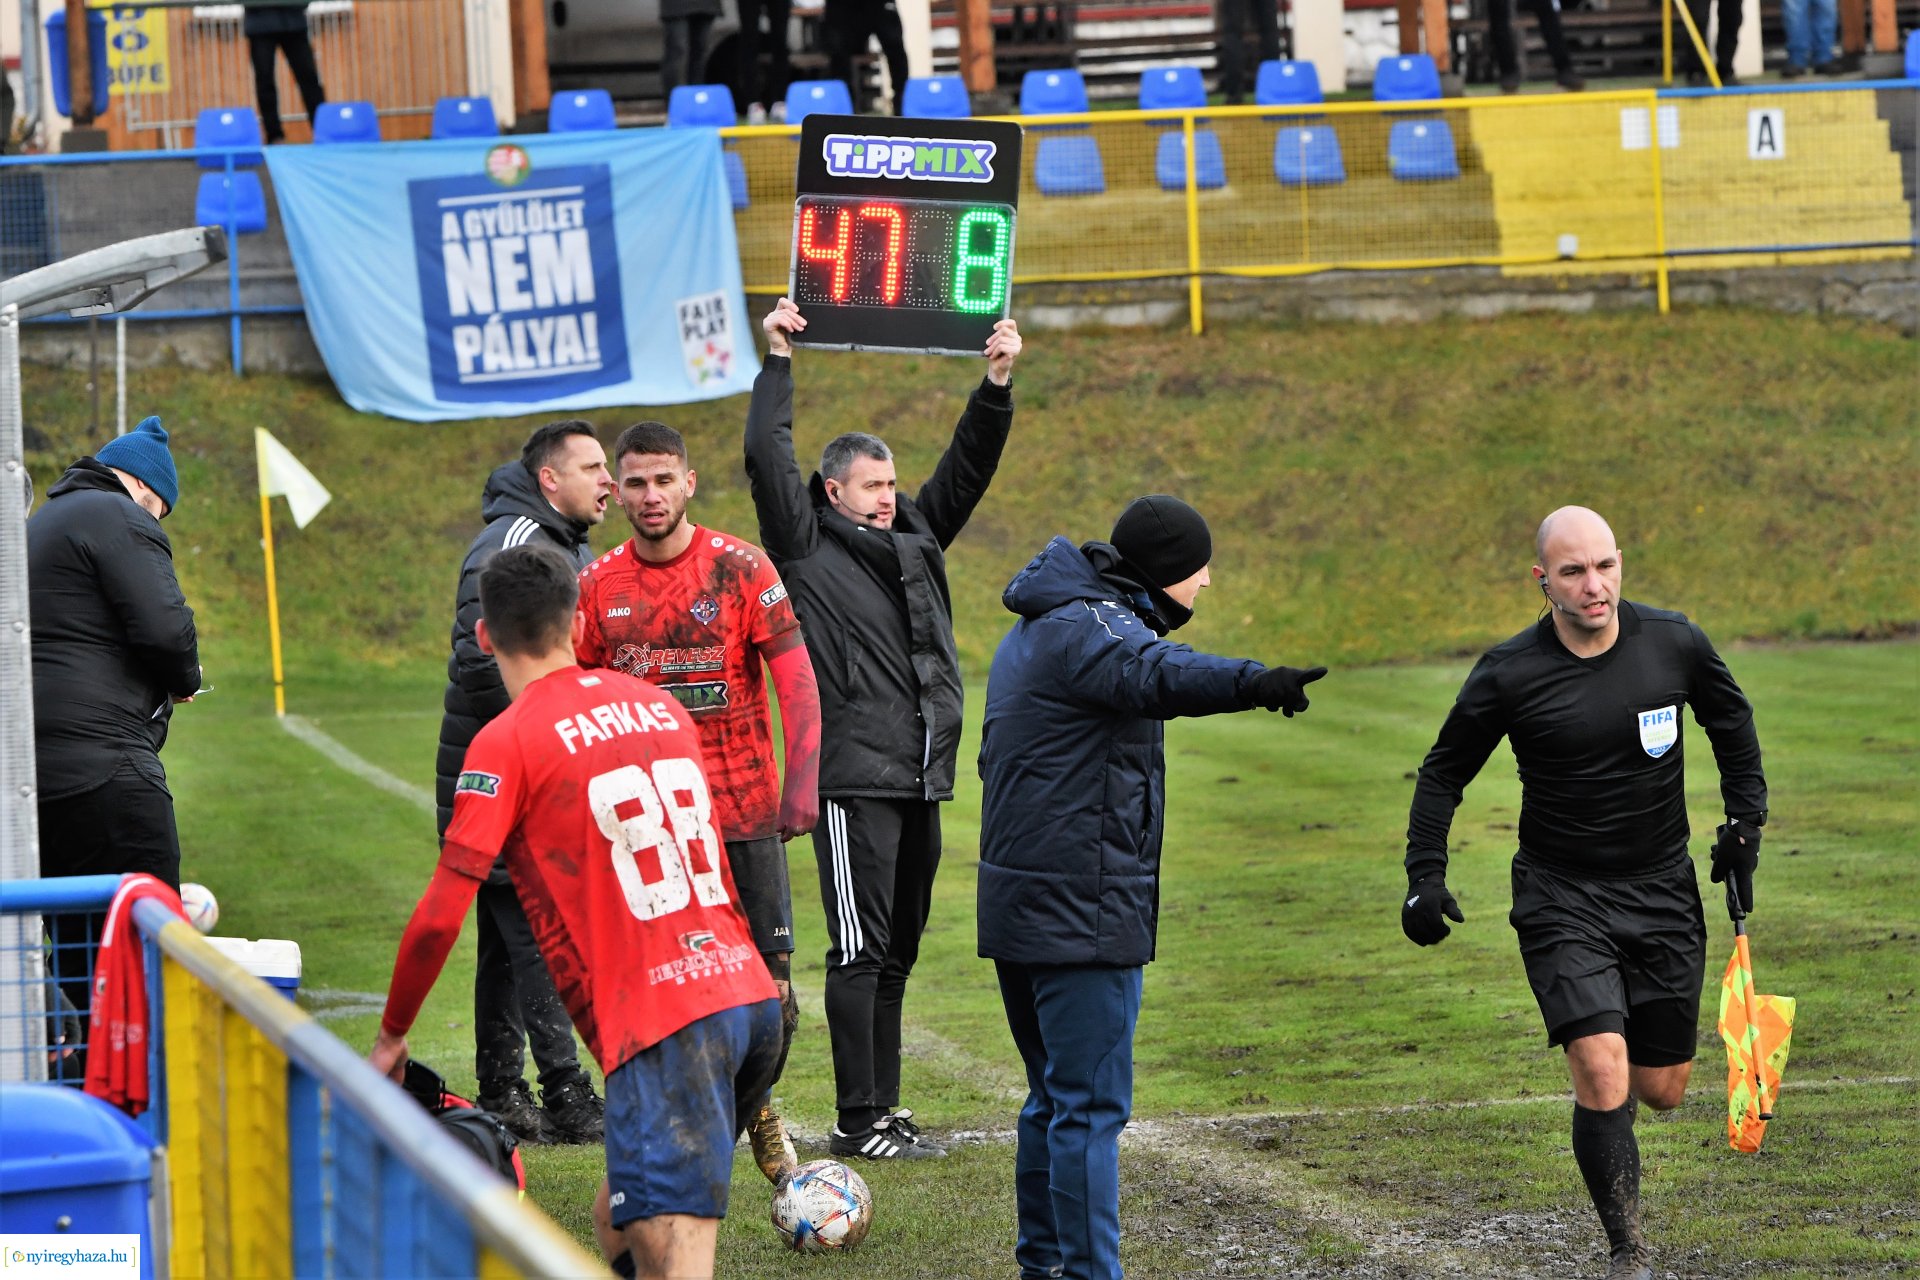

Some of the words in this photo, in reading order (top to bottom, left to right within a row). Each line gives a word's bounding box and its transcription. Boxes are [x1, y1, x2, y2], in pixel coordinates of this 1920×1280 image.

[1757, 115, 1775, 151] A
[442, 211, 462, 241] A
[443, 228, 595, 317] NEM
[802, 202, 901, 303] 47
[954, 210, 1007, 312] 8
[680, 296, 723, 321] FAIR
[453, 312, 600, 374] PÁLYA!
[684, 317, 726, 341] PLAY
[607, 607, 631, 618] JAKO
[554, 702, 680, 755] FARKAS
[1643, 710, 1673, 727] FIFA
[588, 757, 730, 922] 88
